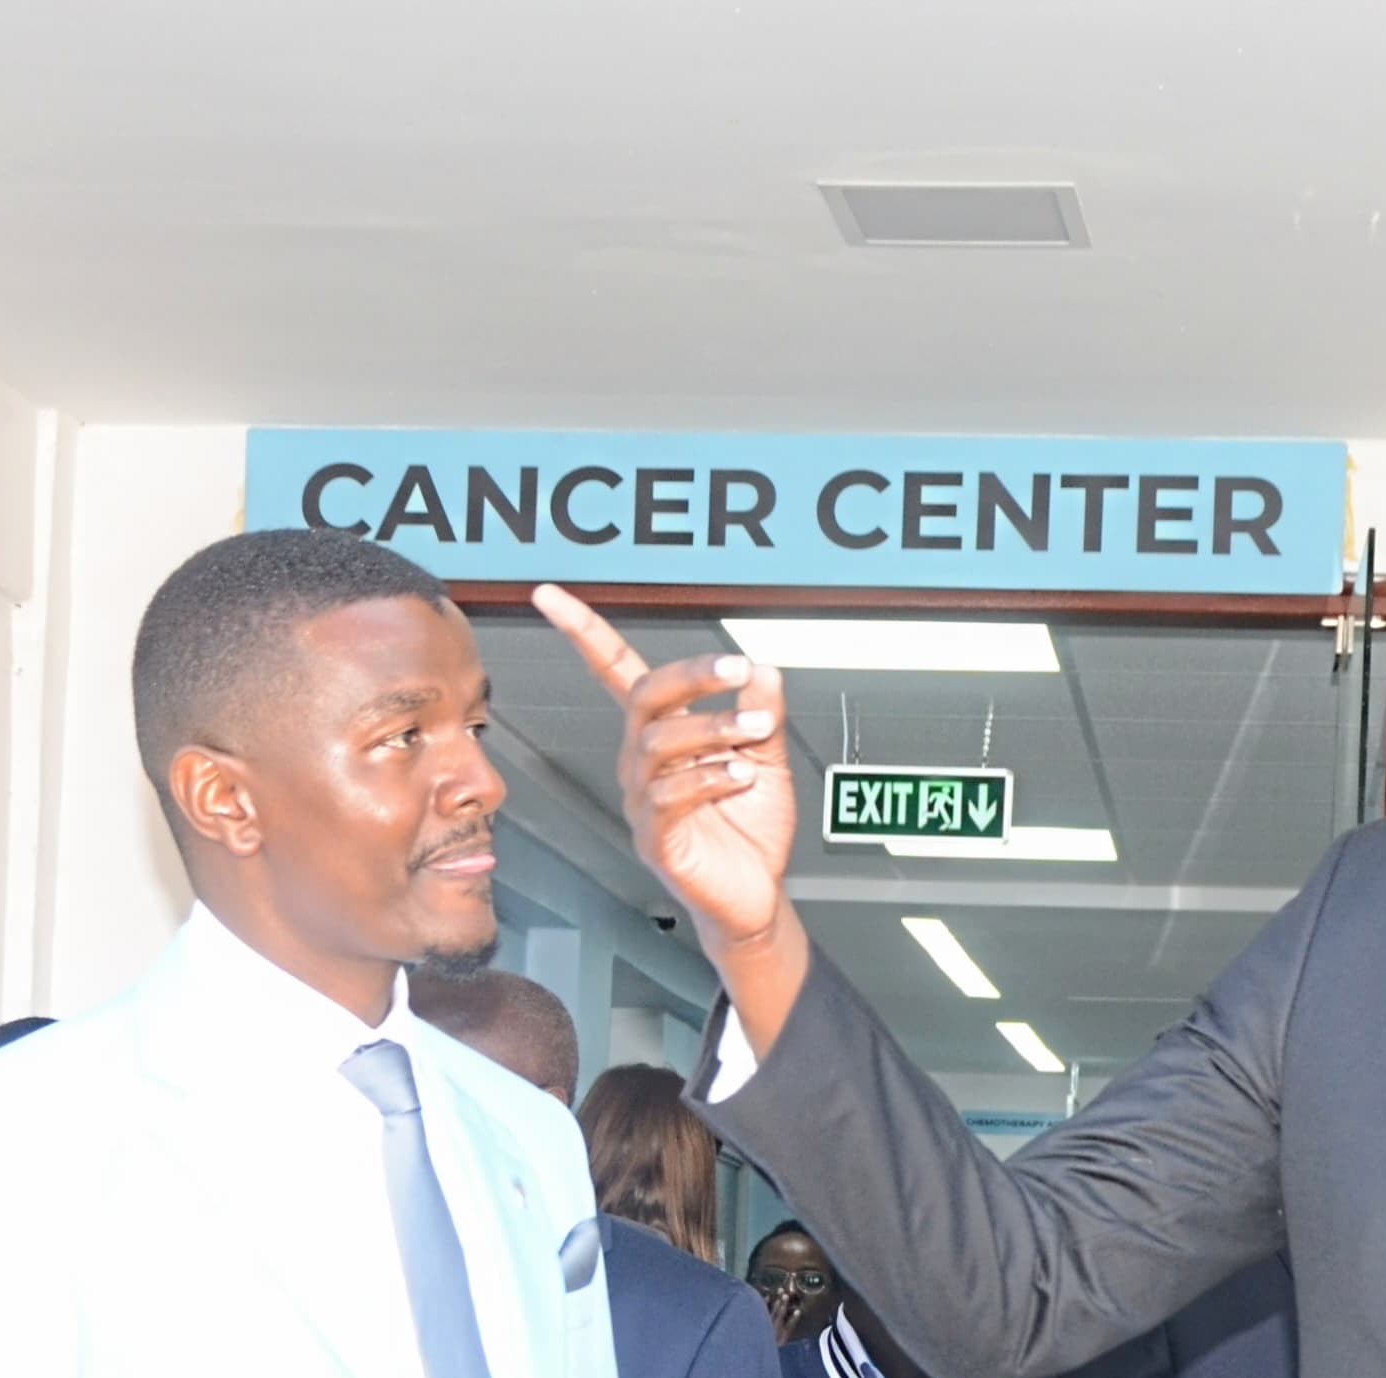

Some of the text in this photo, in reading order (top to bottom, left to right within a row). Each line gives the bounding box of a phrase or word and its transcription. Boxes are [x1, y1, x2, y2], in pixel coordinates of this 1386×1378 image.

[300, 461, 1284, 556] CANCER CENTER
[838, 780, 913, 825] EXIT
[966, 1118, 1044, 1127] CHEMOTHERAPY
